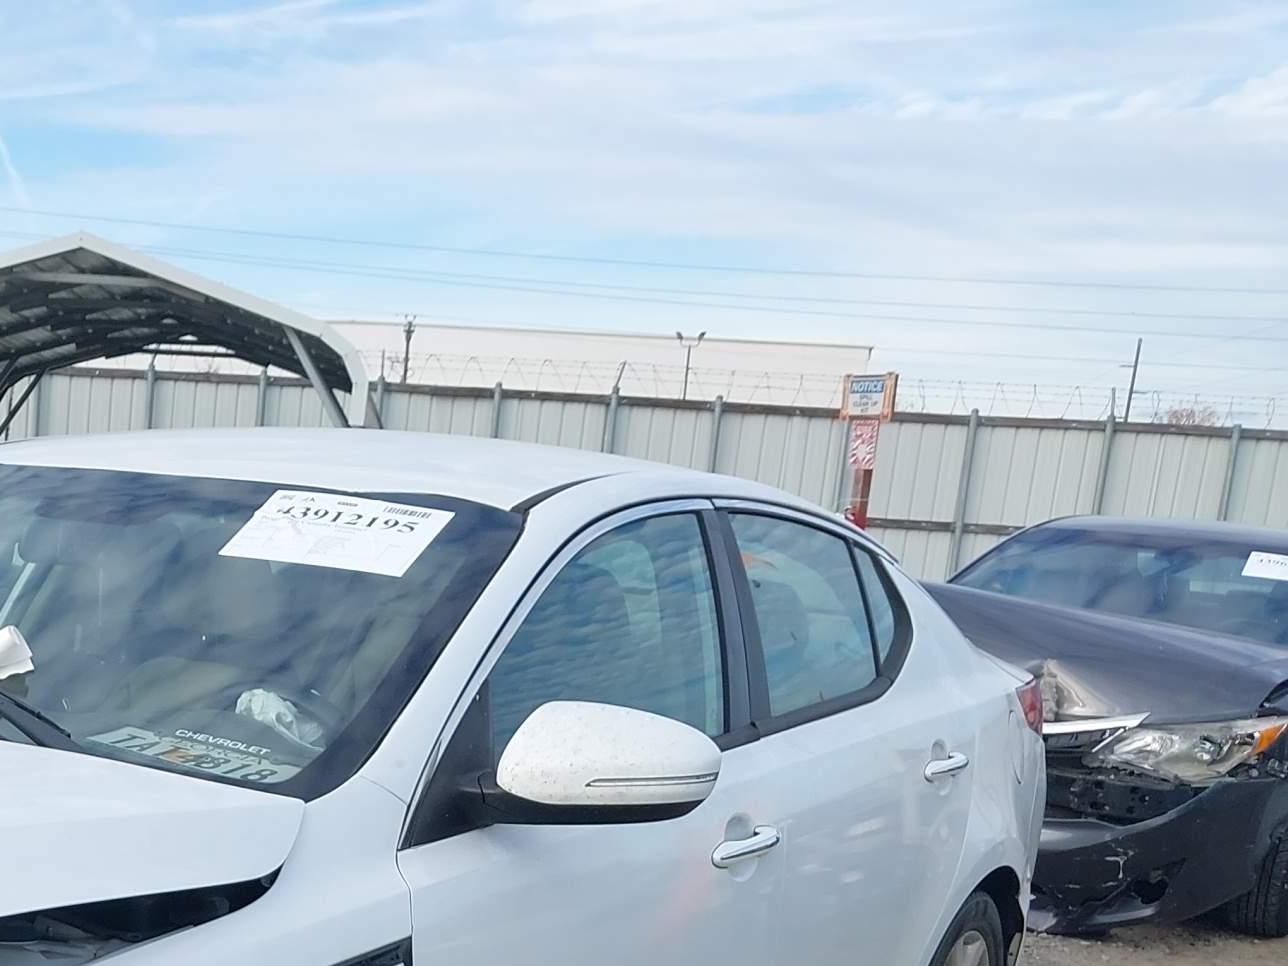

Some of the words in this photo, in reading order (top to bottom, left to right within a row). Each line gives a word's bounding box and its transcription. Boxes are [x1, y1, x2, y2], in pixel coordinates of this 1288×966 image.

[850, 381, 884, 393] NOTICE
[276, 505, 420, 534] 43912195
[175, 728, 271, 755] CHEVROLET
